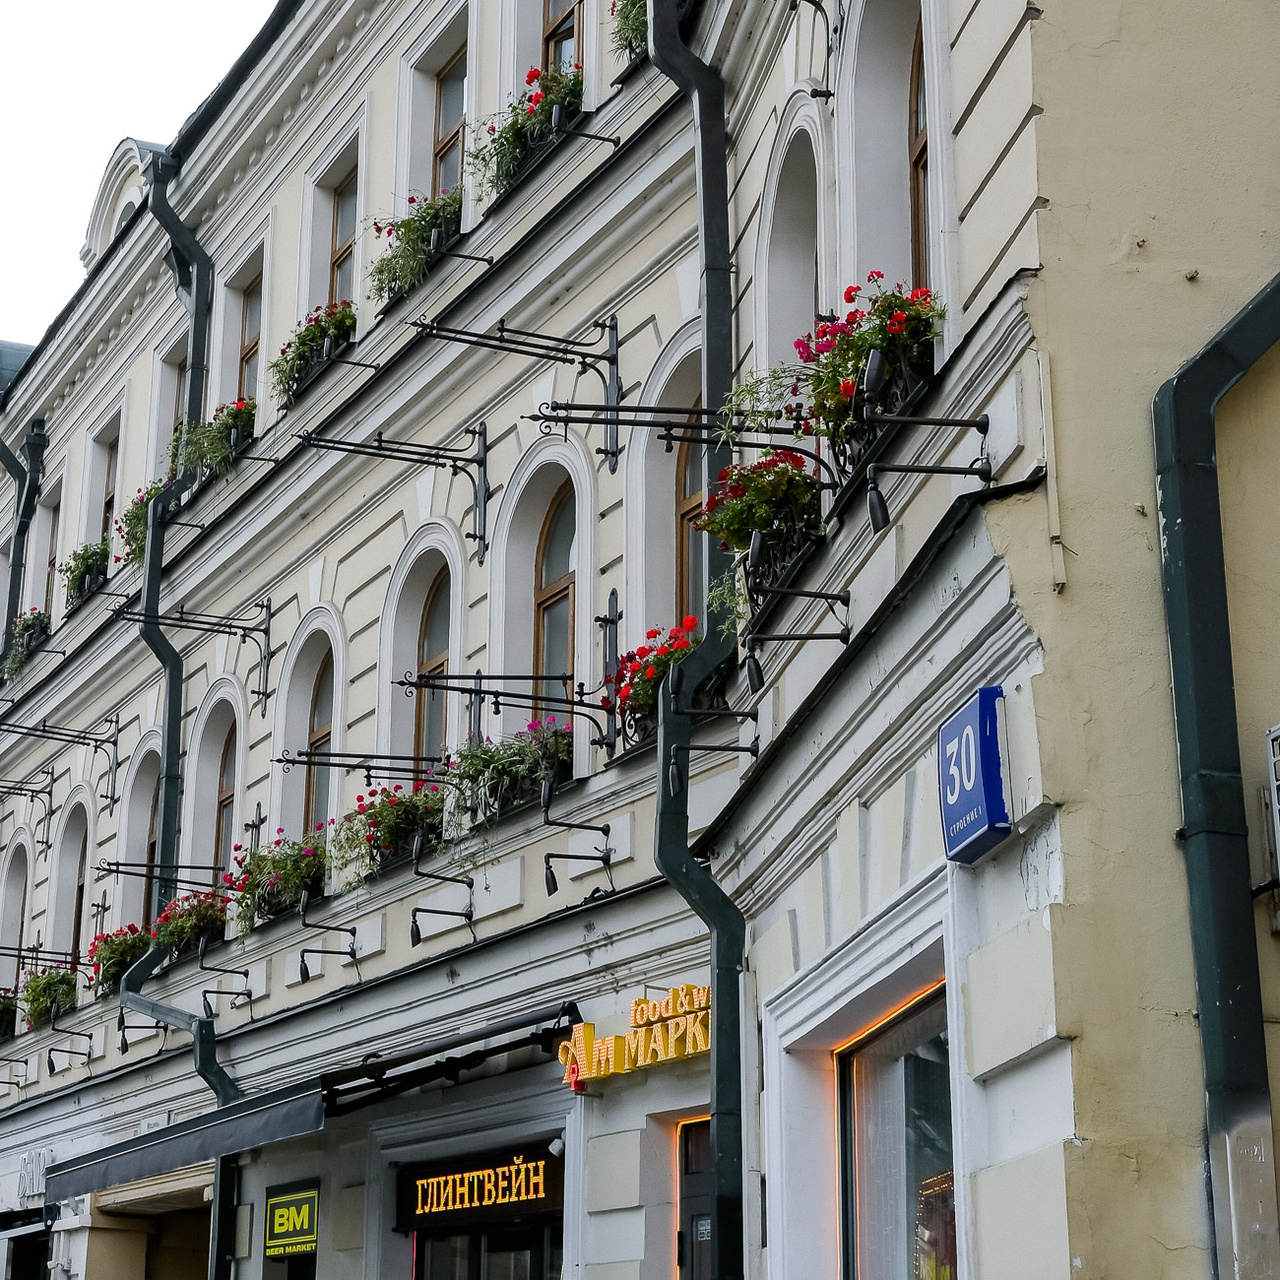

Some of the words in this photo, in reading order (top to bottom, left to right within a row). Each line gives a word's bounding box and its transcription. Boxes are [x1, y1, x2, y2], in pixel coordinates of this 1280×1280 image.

[946, 725, 976, 805] 30
[949, 809, 978, 837] СТРОЕНИЕ
[415, 1155, 546, 1215] ГЛИНТВЕЙН
[273, 1203, 309, 1234] BM
[265, 1246, 284, 1257] BEER
[285, 1242, 317, 1254] MARKET
